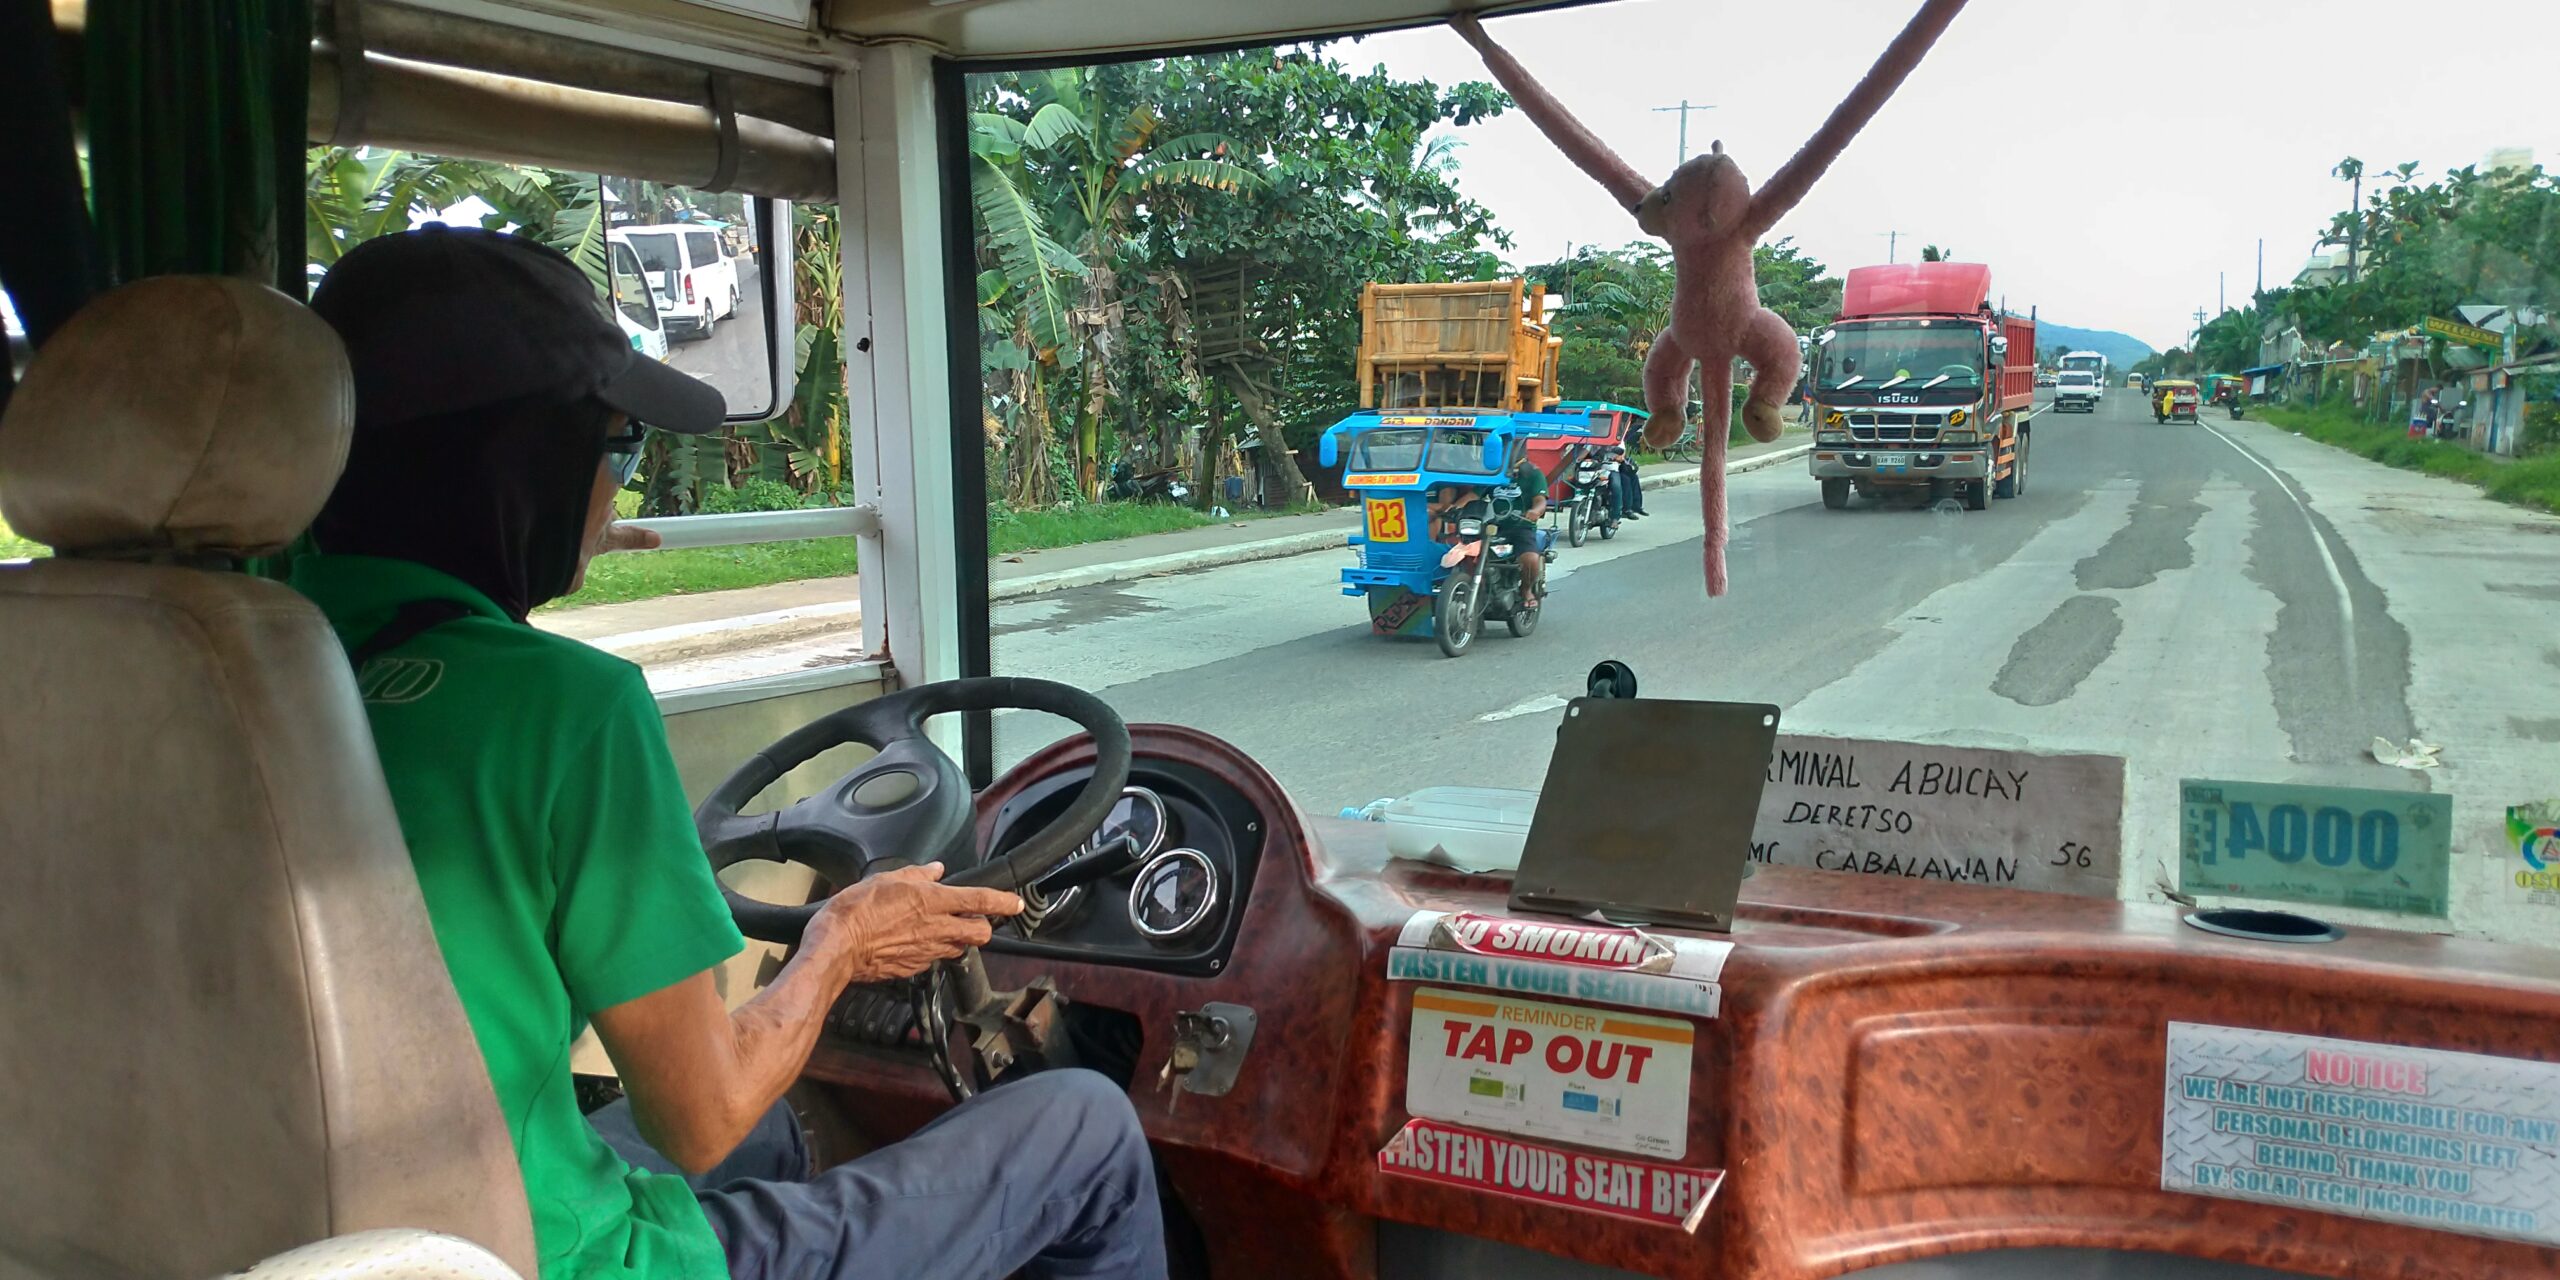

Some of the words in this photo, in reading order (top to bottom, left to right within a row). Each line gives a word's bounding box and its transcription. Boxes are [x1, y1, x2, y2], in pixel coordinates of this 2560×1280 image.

[1878, 392, 1919, 404] ISUZU
[1424, 417, 1474, 426] DANDAN
[1368, 501, 1405, 539] 123
[1888, 760, 2029, 801] ABUCAY
[1782, 801, 1913, 835] DERETSO
[1815, 849, 2019, 883] CABALAWAN
[1492, 922, 1660, 964] SMOKIN
[1391, 952, 1489, 986] FASTEN
[1502, 1005, 1597, 1032] REMINDER
[1443, 1019, 1534, 1065] TAP
[1545, 1034, 1653, 1084] OUT
[2307, 1050, 2426, 1094] NOTICE
[2183, 1076, 2218, 1100] WE
[2220, 1080, 2261, 1106] ARE
[2264, 1086, 2307, 1112] NOT
[2310, 1090, 2458, 1131] RESPONSIBLE
[2462, 1111, 2506, 1137] FOR
[2510, 1116, 2558, 1144] ANY
[2215, 1109, 2322, 1143] PERSONAL
[2325, 1122, 2465, 1163] BELONGINGS
[2468, 1142, 2519, 1170] LEFT
[1490, 1139, 1567, 1196] YOUR
[1575, 1157, 1645, 1209] SEAT
[2346, 1155, 2418, 1187] THANK
[2425, 1167, 2471, 1194] YOU
[2232, 1167, 2299, 1197] SOLAR
[2303, 1179, 2359, 1206] TECH
[2363, 1187, 2535, 1231] INCORPORATED
